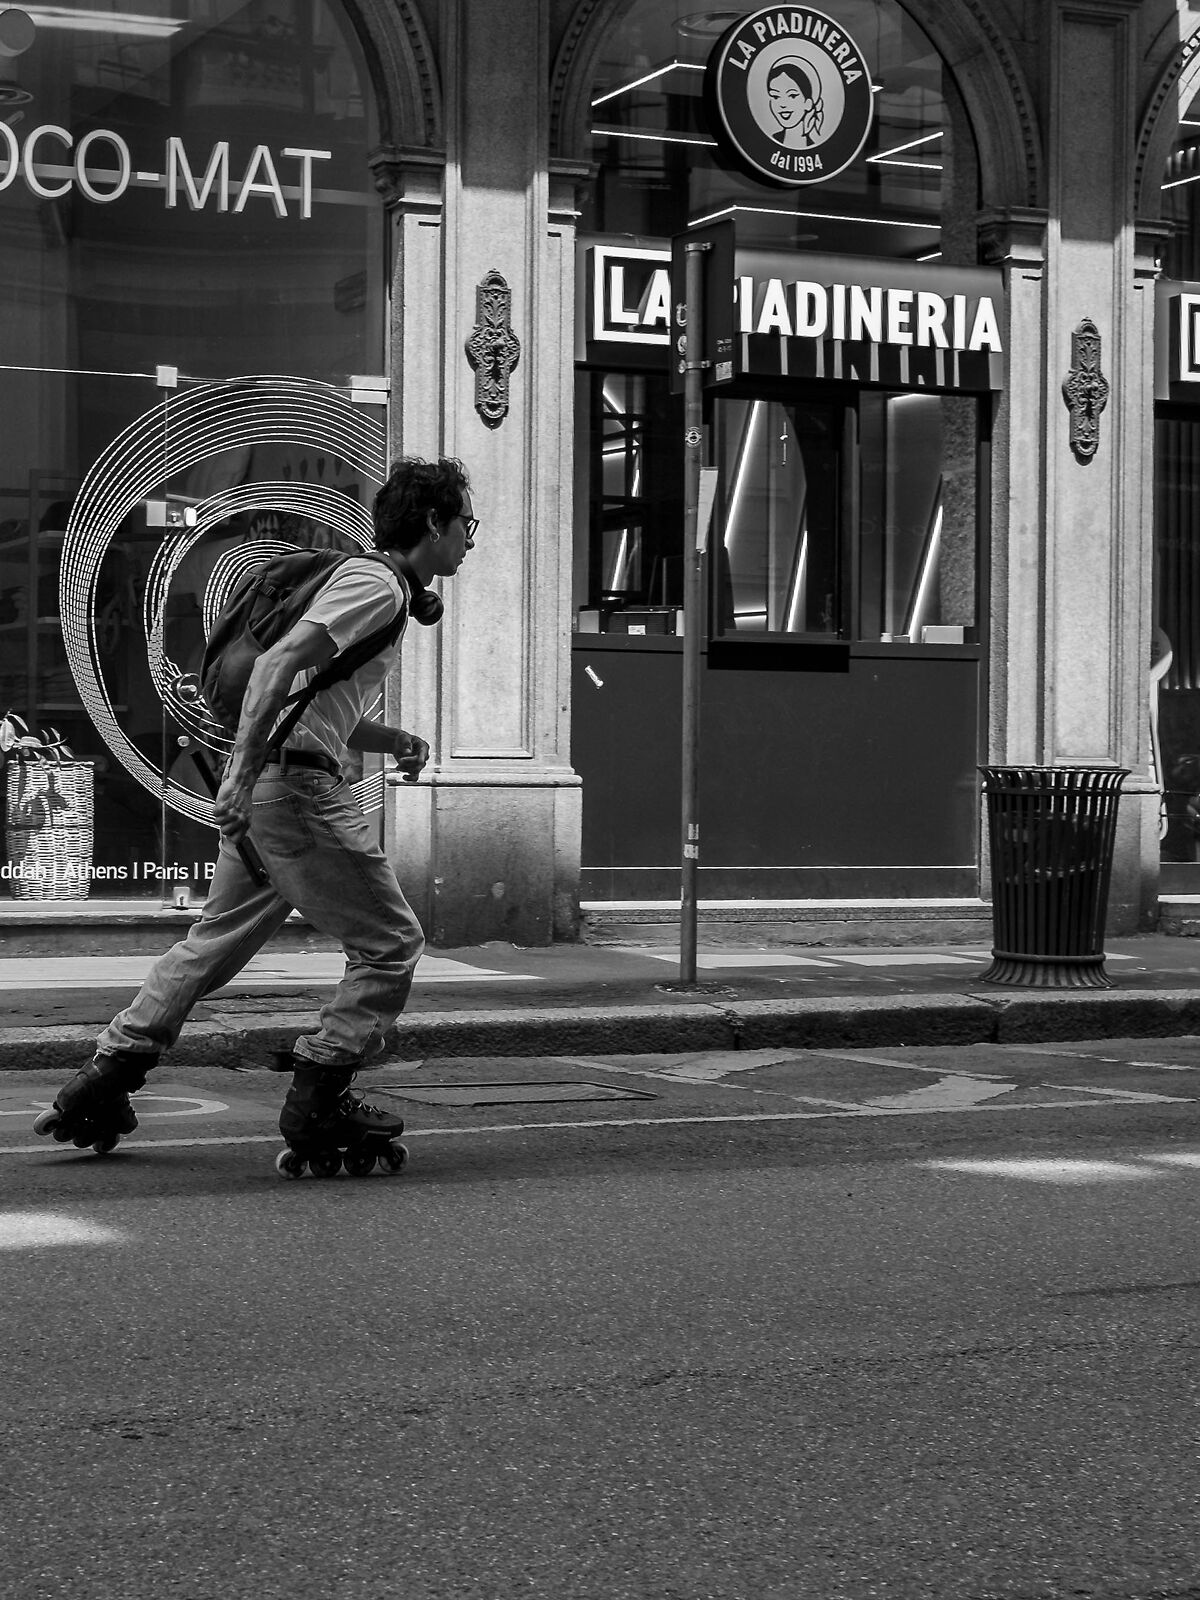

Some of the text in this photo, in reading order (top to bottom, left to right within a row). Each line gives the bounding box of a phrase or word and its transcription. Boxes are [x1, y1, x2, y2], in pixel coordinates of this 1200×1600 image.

[729, 12, 863, 85] LA PIADINERIA
[770, 151, 823, 172] dal 1994
[734, 276, 1003, 353] IADINERIA
[62, 861, 128, 880] Athens
[143, 861, 189, 879] Paris
